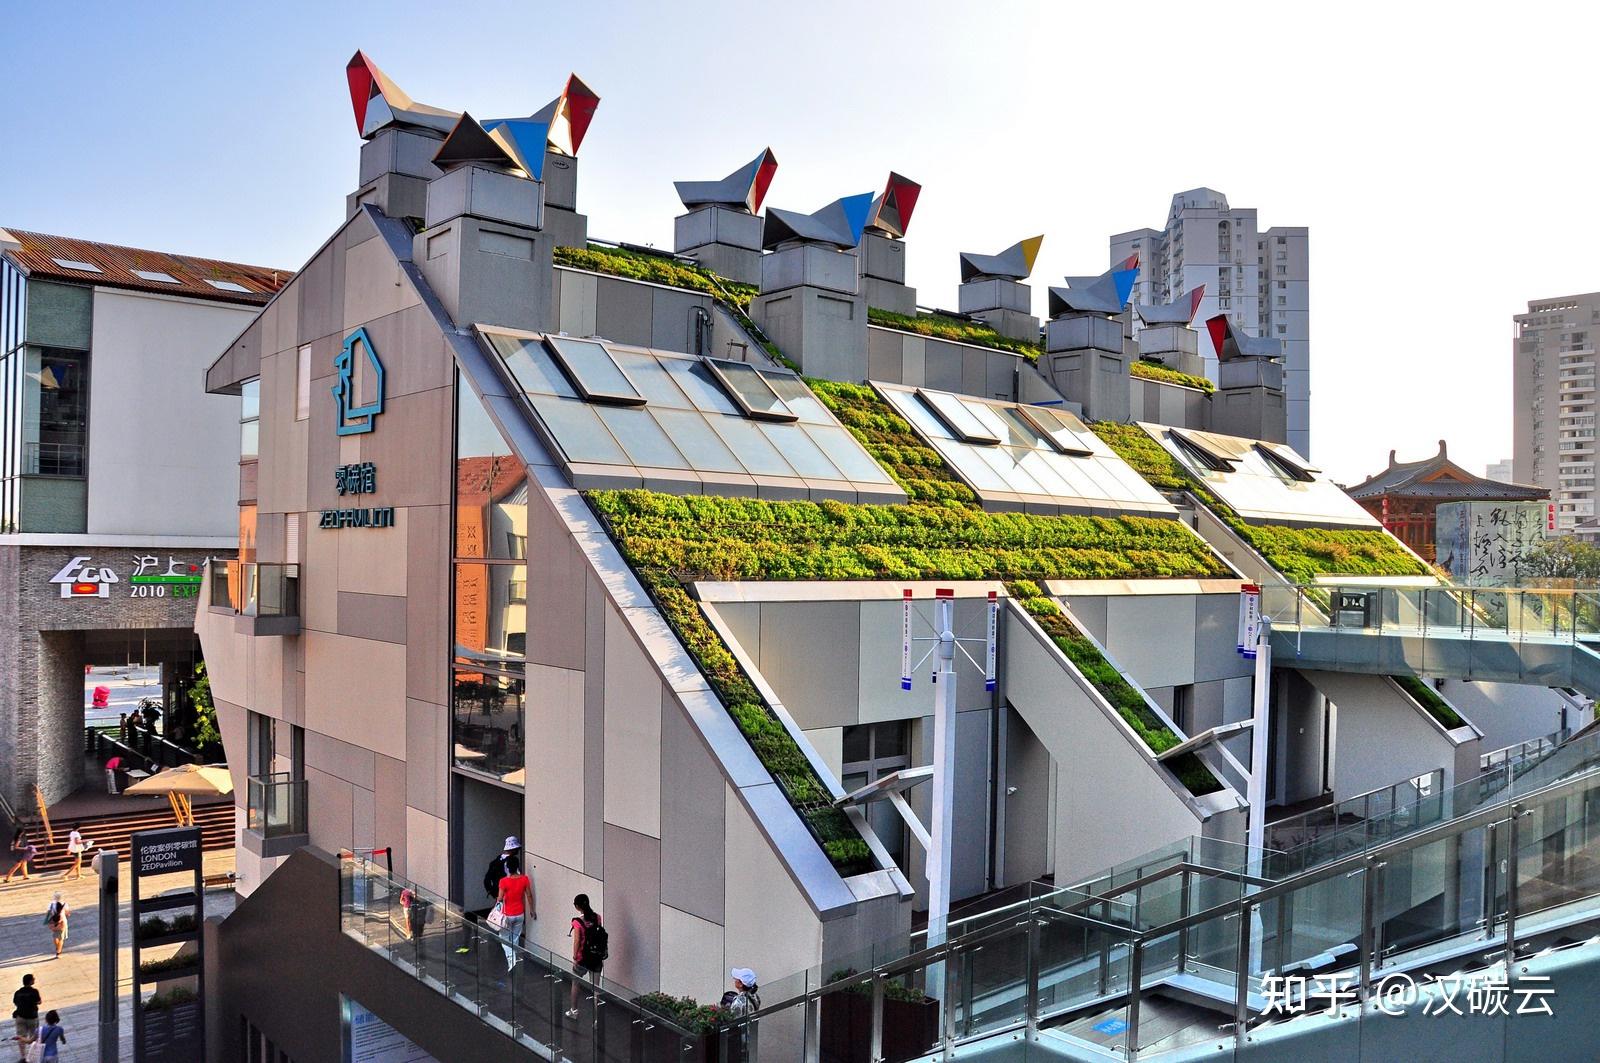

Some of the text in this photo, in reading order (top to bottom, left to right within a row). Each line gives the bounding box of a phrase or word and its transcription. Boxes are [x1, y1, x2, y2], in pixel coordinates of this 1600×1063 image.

[335, 462, 376, 495] 零碳馆
[130, 585, 199, 598] 2010 EXP
[141, 852, 177, 863] LONDON
[141, 861, 183, 871] ZEDPavilion
